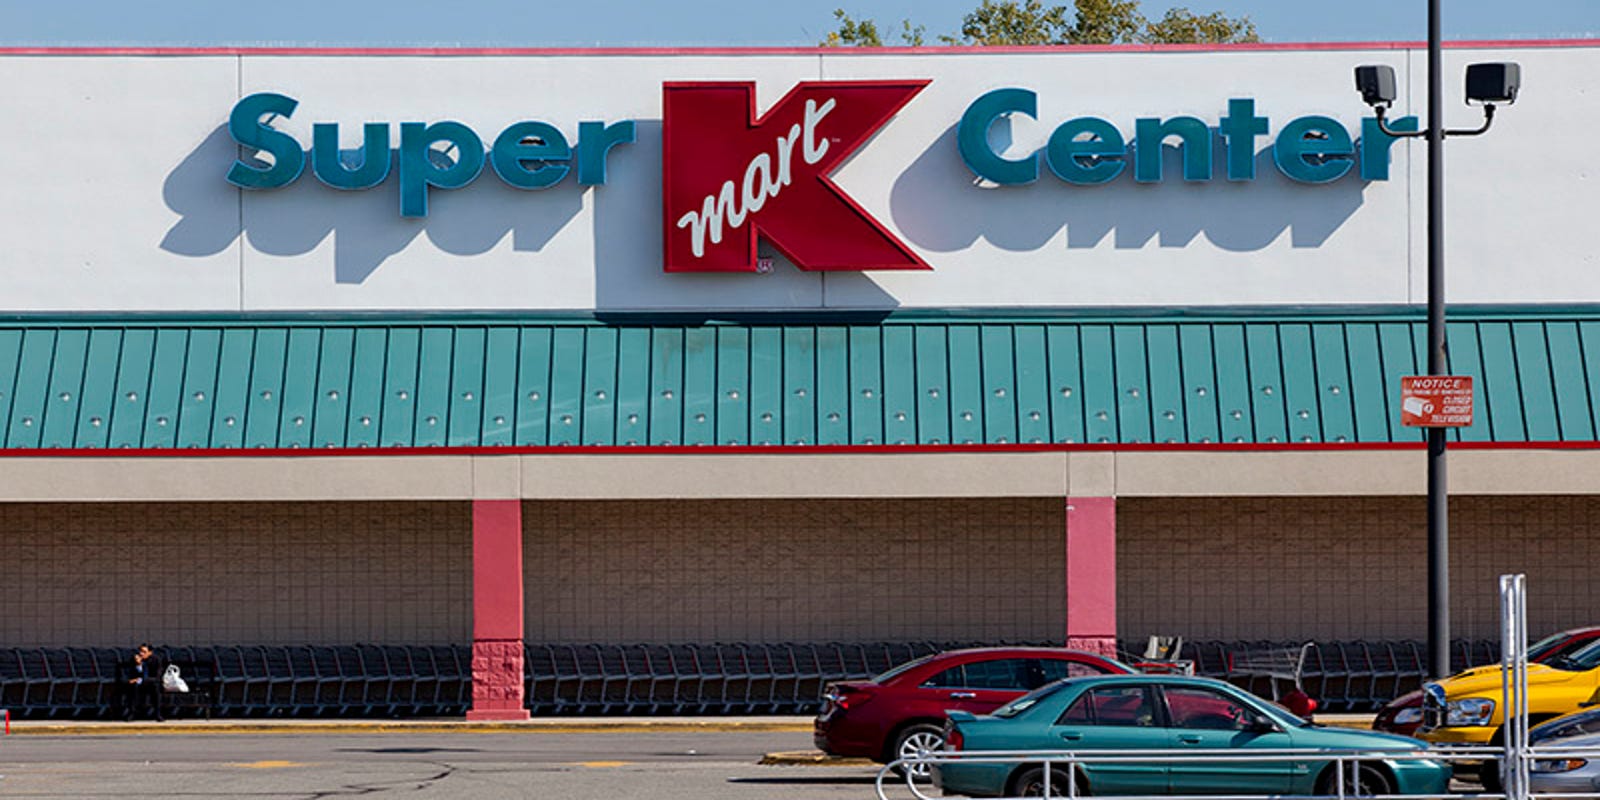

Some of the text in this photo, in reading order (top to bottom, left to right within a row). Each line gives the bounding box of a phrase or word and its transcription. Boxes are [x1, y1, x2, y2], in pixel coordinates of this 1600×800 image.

[225, 79, 1419, 272] Super K mart Center
[1411, 379, 1461, 389] NOTICE
